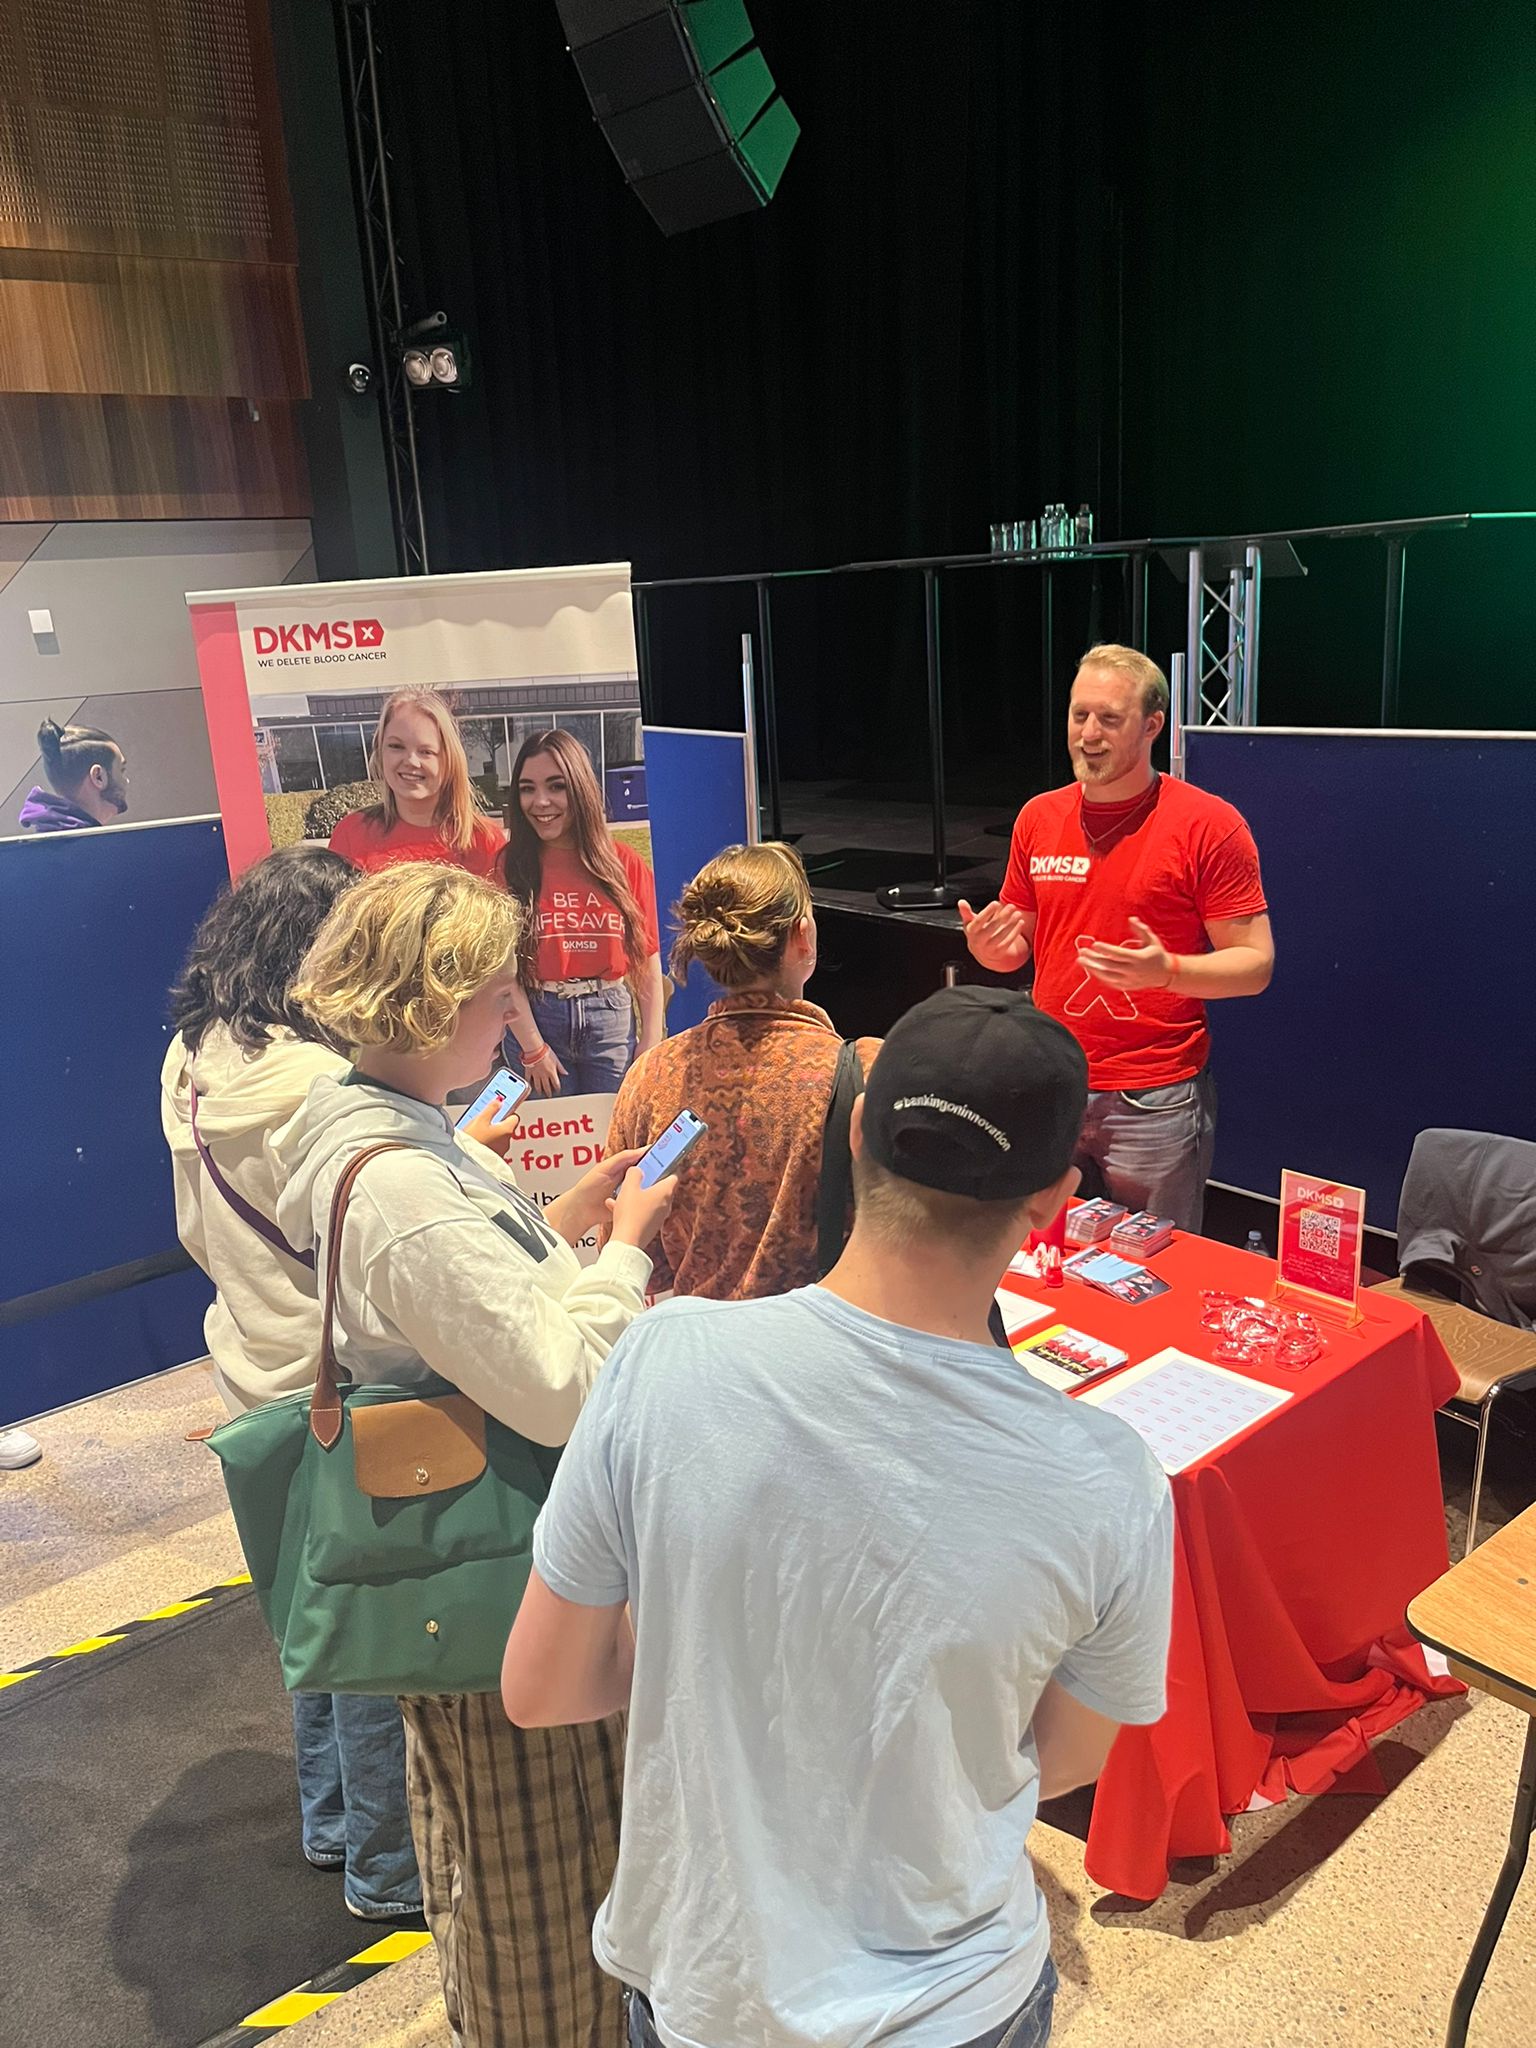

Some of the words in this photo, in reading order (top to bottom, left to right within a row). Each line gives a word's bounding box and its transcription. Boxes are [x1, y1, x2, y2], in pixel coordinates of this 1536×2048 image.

[257, 659, 274, 668] WE
[276, 656, 311, 667] DELETE
[313, 654, 346, 665] BLOOD
[347, 651, 387, 662] CANCER
[553, 892, 580, 909] BE
[585, 892, 602, 908] A
[511, 1114, 594, 1141] udent
[520, 1149, 564, 1171] for
